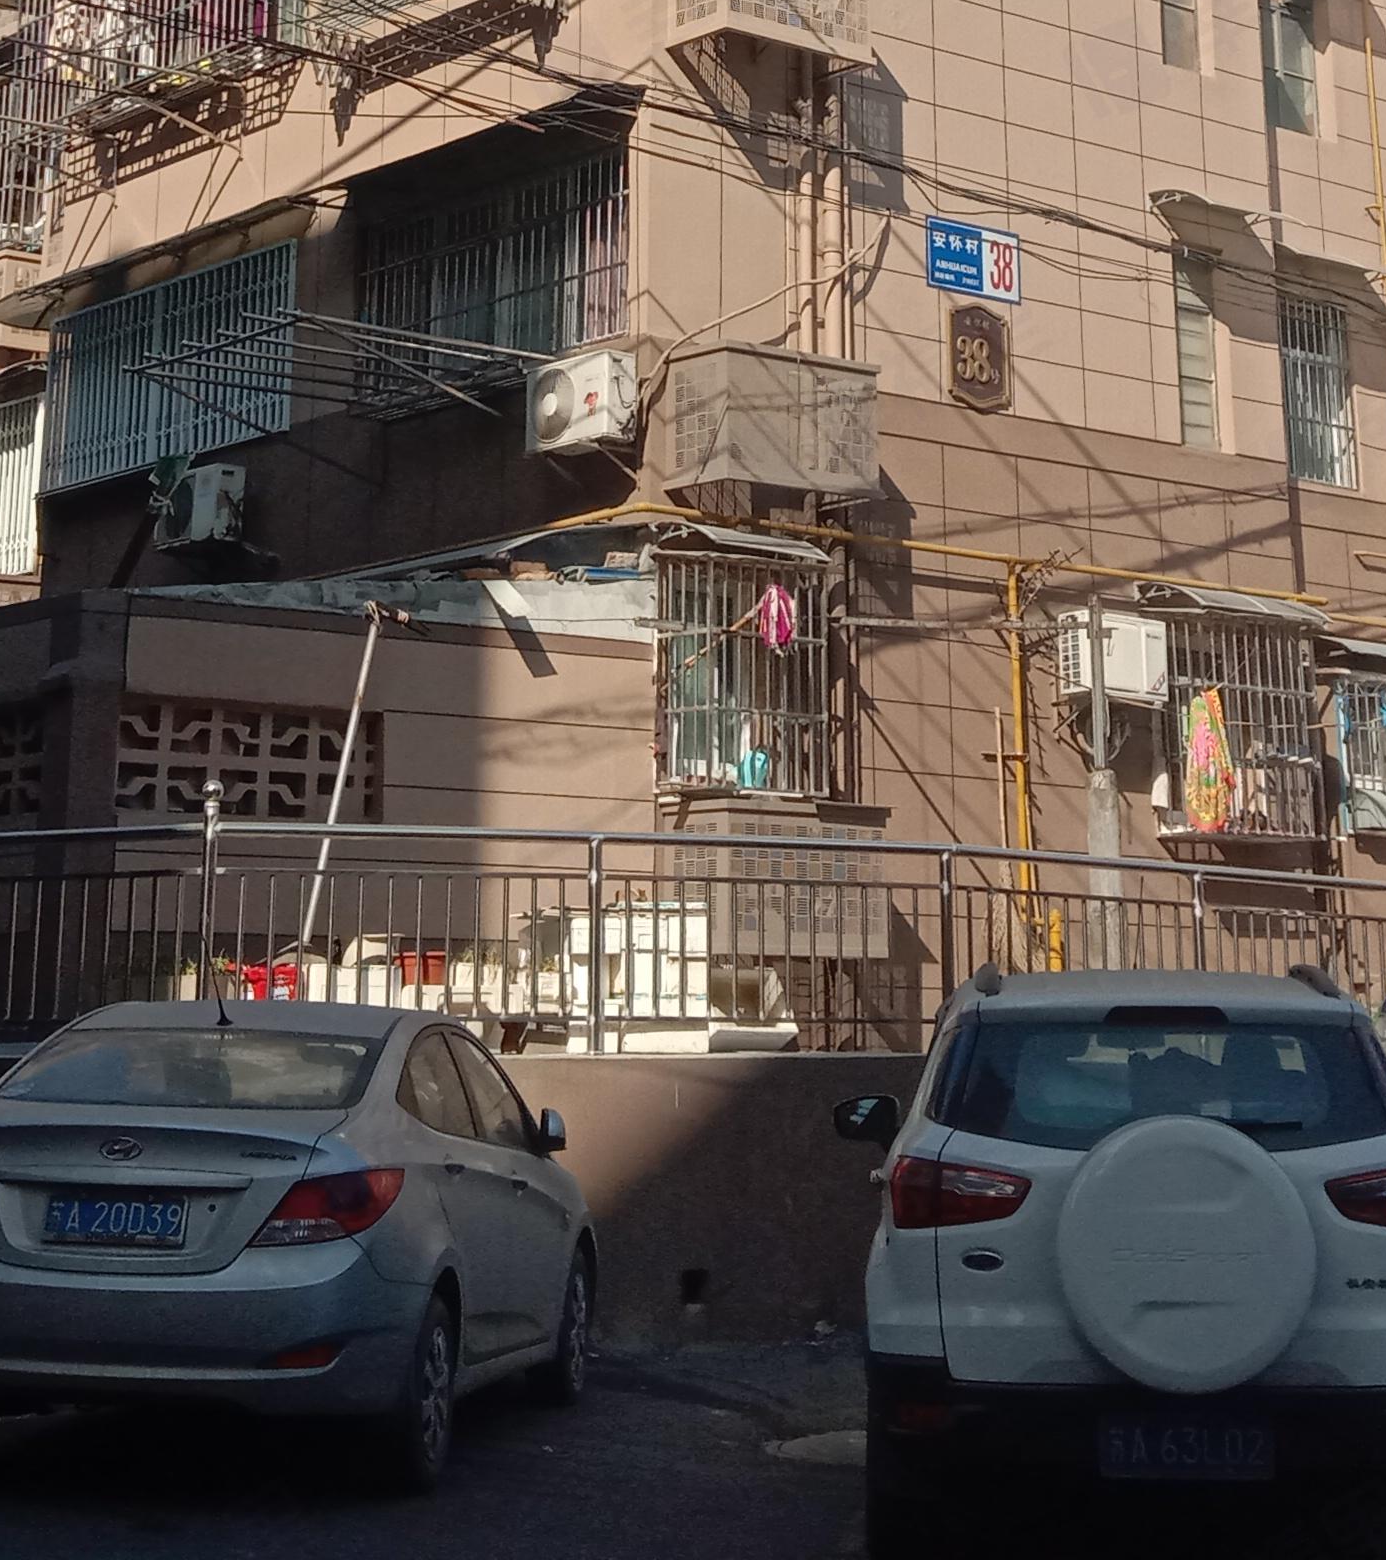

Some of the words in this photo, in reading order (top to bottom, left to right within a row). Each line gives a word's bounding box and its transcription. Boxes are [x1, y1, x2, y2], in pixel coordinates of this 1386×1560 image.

[932, 231, 979, 255] 安怀村
[990, 241, 1013, 292] 38
